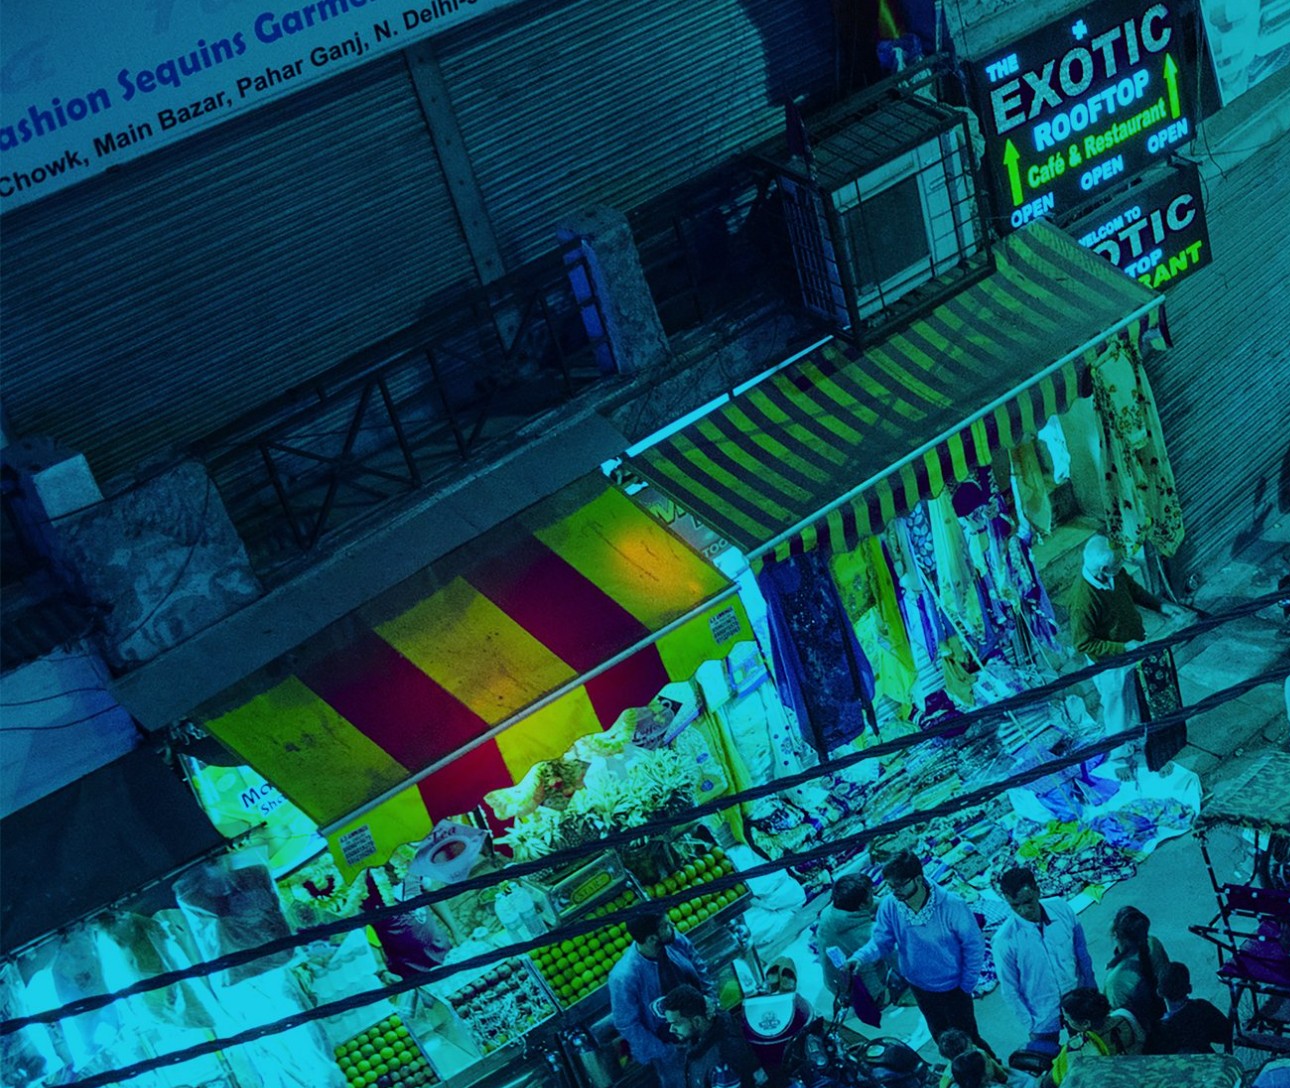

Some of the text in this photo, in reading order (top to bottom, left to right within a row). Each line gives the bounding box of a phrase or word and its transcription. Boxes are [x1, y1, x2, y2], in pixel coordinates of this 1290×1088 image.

[0, 149, 90, 198] Chowk,
[93, 122, 153, 158] Main
[157, 89, 233, 130] Bazar,
[236, 58, 304, 100] Pahar
[309, 31, 371, 68] Ganj,
[373, 19, 398, 44] N.
[117, 31, 247, 102] Sequins
[985, 53, 1019, 82] THE
[989, 3, 1172, 135] EXOTIC
[1032, 68, 1150, 152] ROOFTOP
[1011, 118, 1188, 228] OPEN OPEN OPEN
[1027, 96, 1166, 189] Café & Restaurant
[1124, 206, 1141, 223] TO
